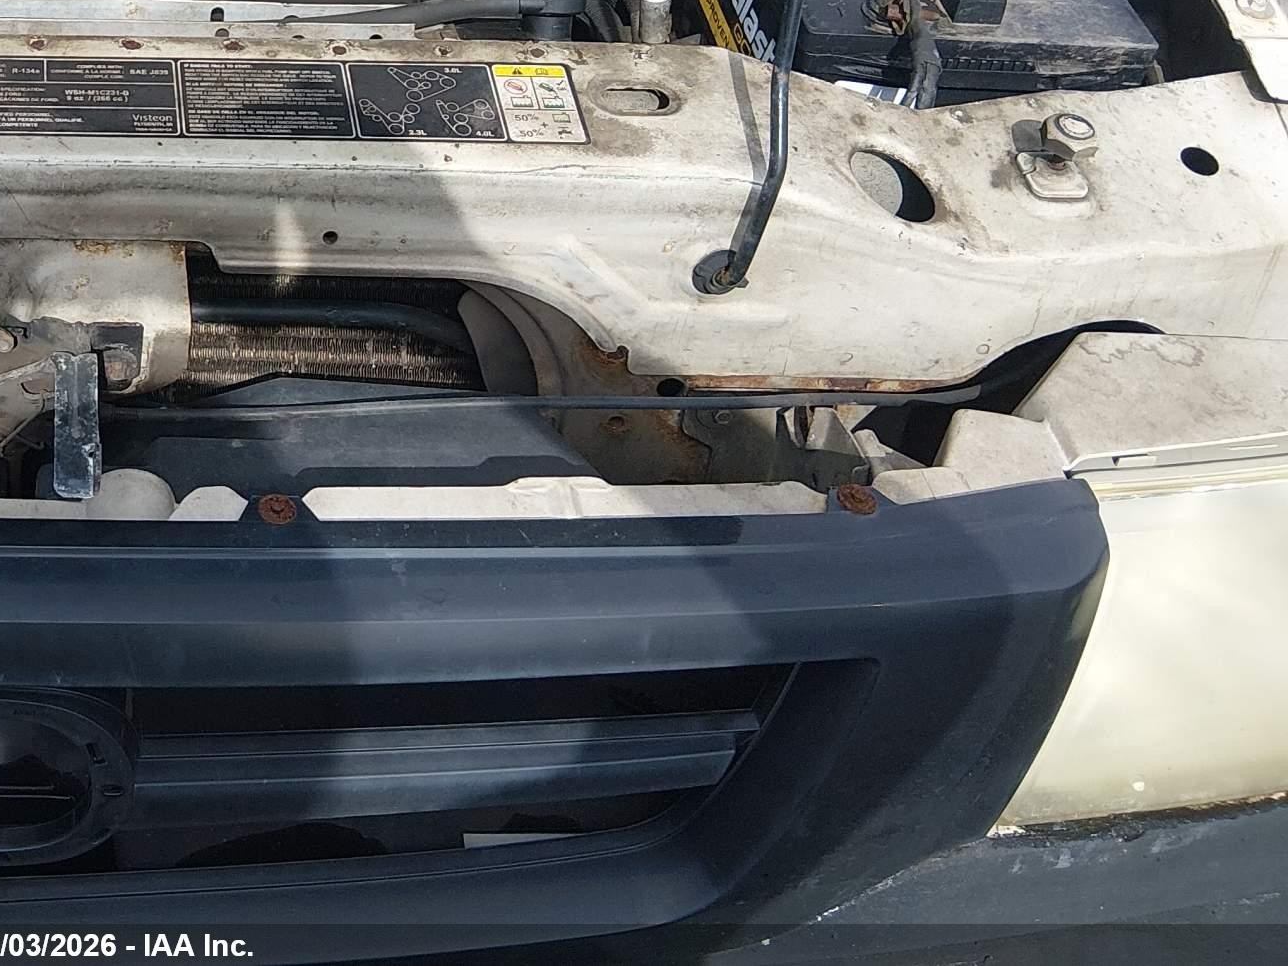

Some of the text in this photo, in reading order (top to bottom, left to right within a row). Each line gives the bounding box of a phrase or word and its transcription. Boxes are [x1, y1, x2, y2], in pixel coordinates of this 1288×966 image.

[132, 114, 173, 122] Visteon
[514, 113, 539, 121] 50%
[520, 129, 544, 137] 50%
